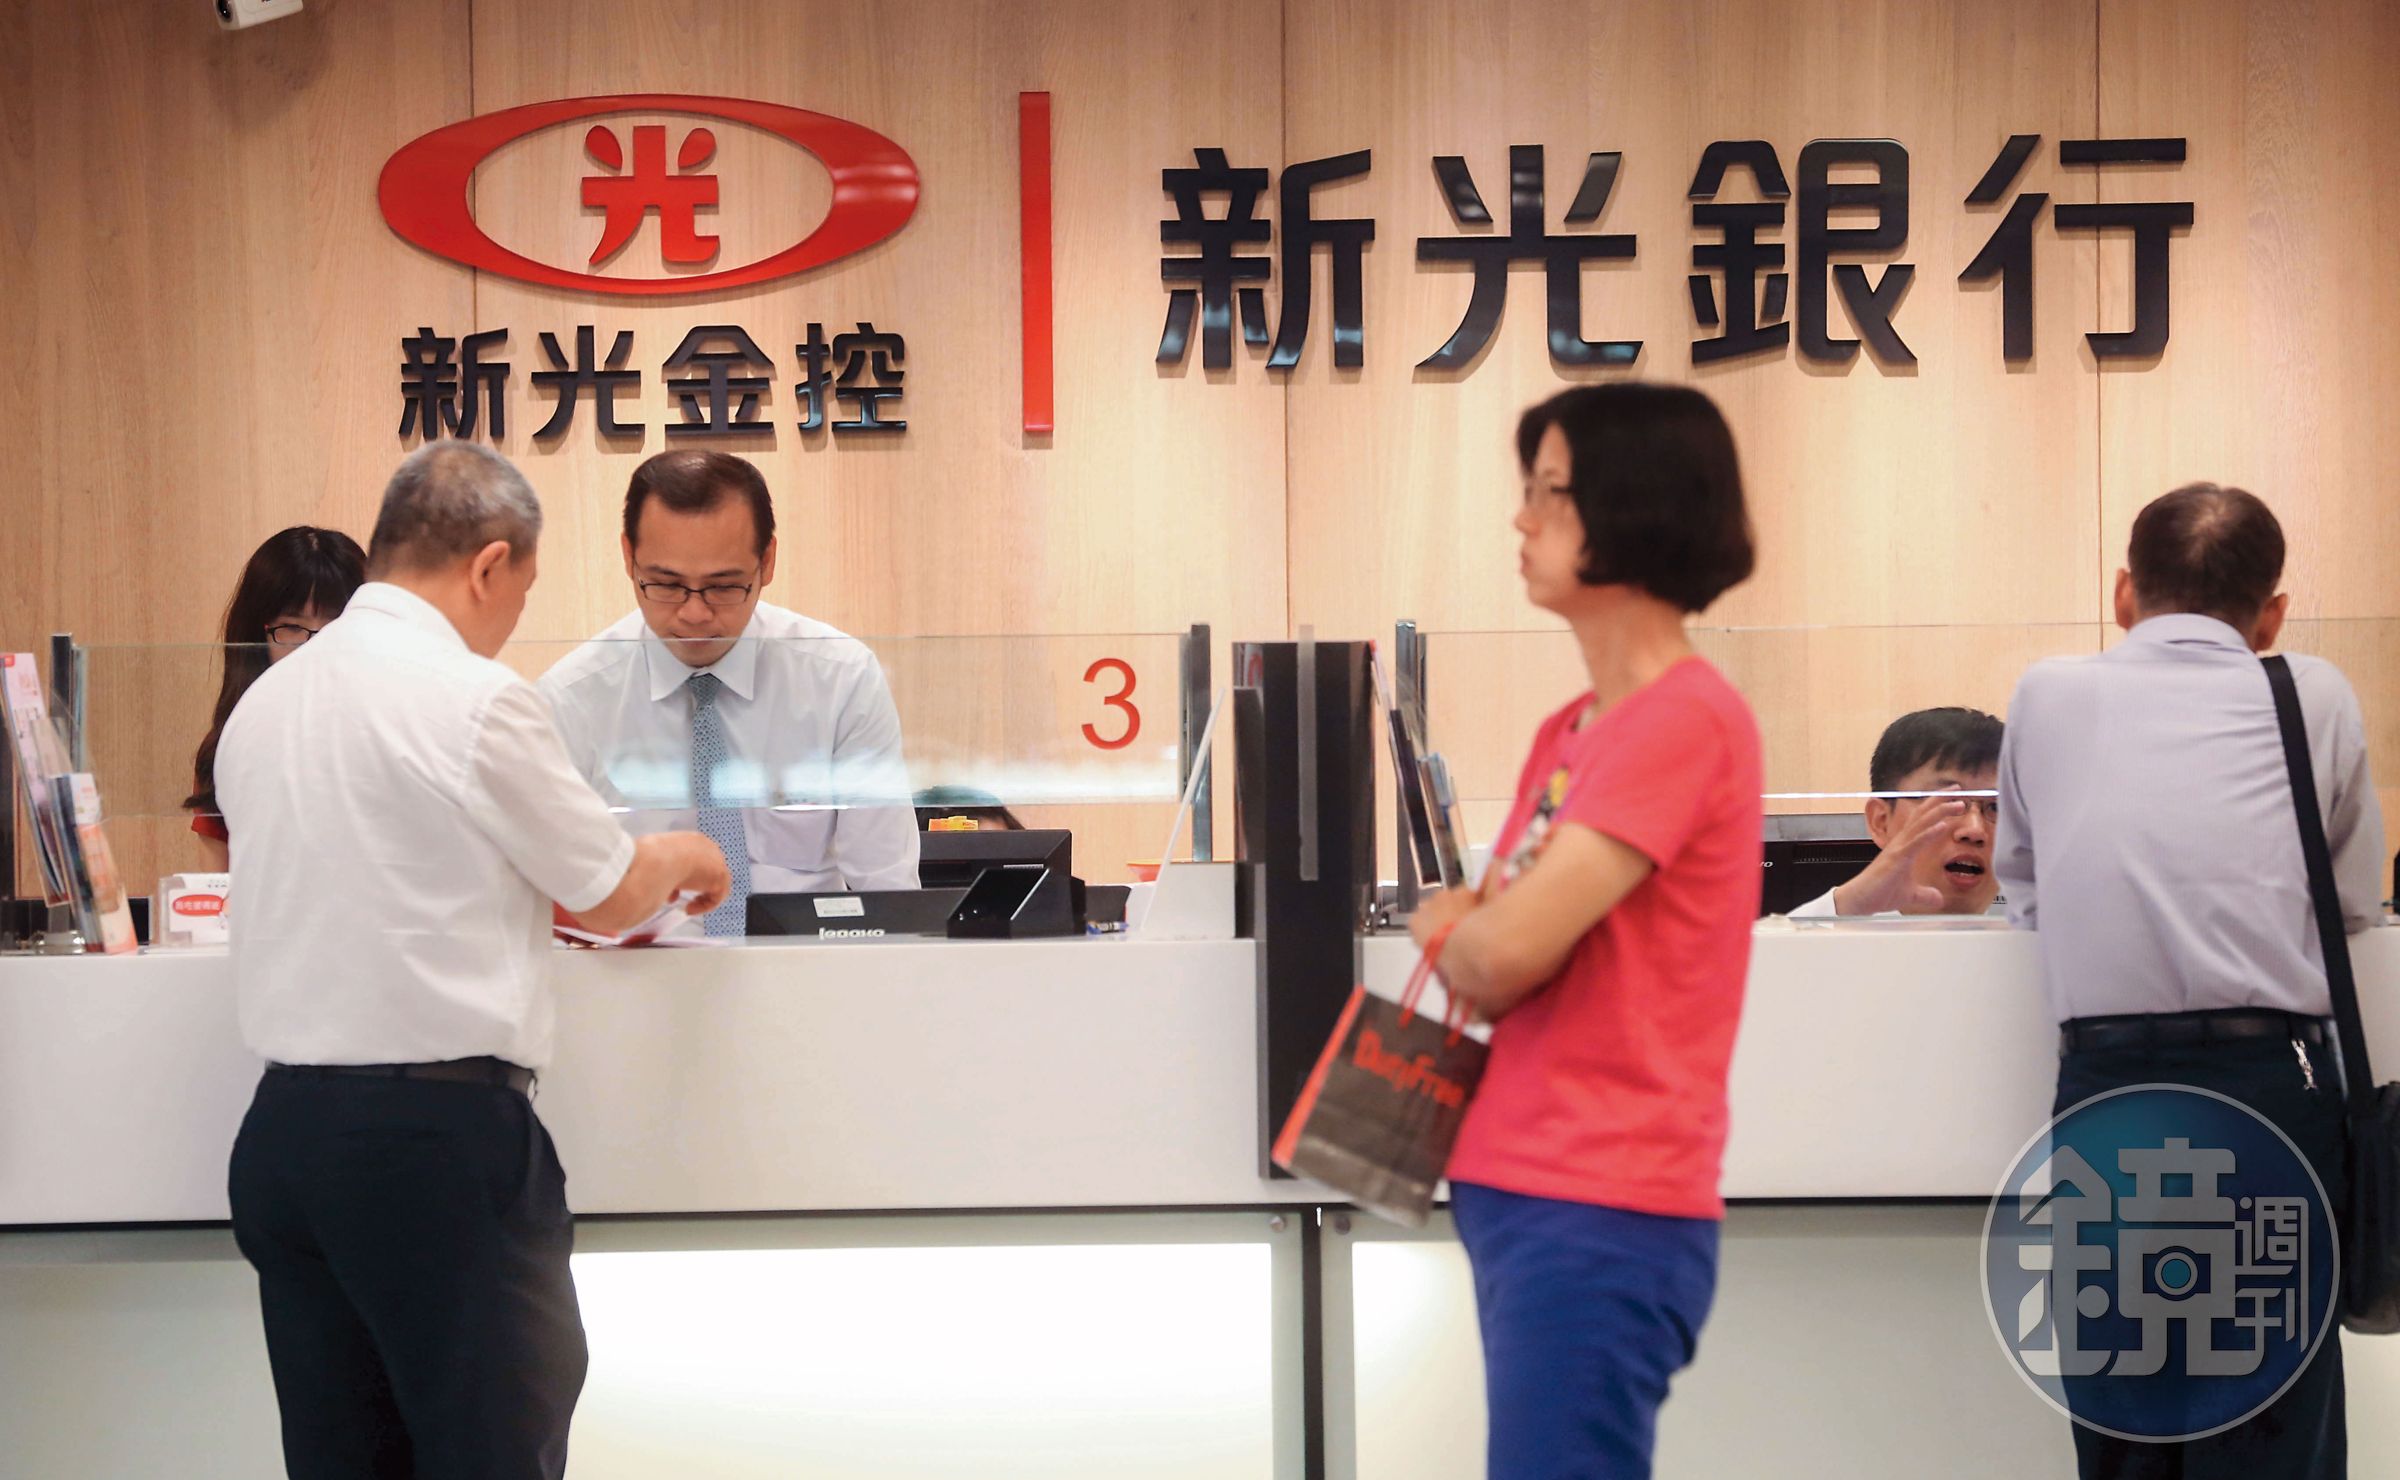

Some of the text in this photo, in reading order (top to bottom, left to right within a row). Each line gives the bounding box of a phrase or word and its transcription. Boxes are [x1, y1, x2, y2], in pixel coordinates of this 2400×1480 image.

[581, 124, 721, 265] 光
[1155, 135, 2195, 370] 新光銀行
[398, 322, 908, 440] 新光金控
[1081, 657, 1141, 751] 3
